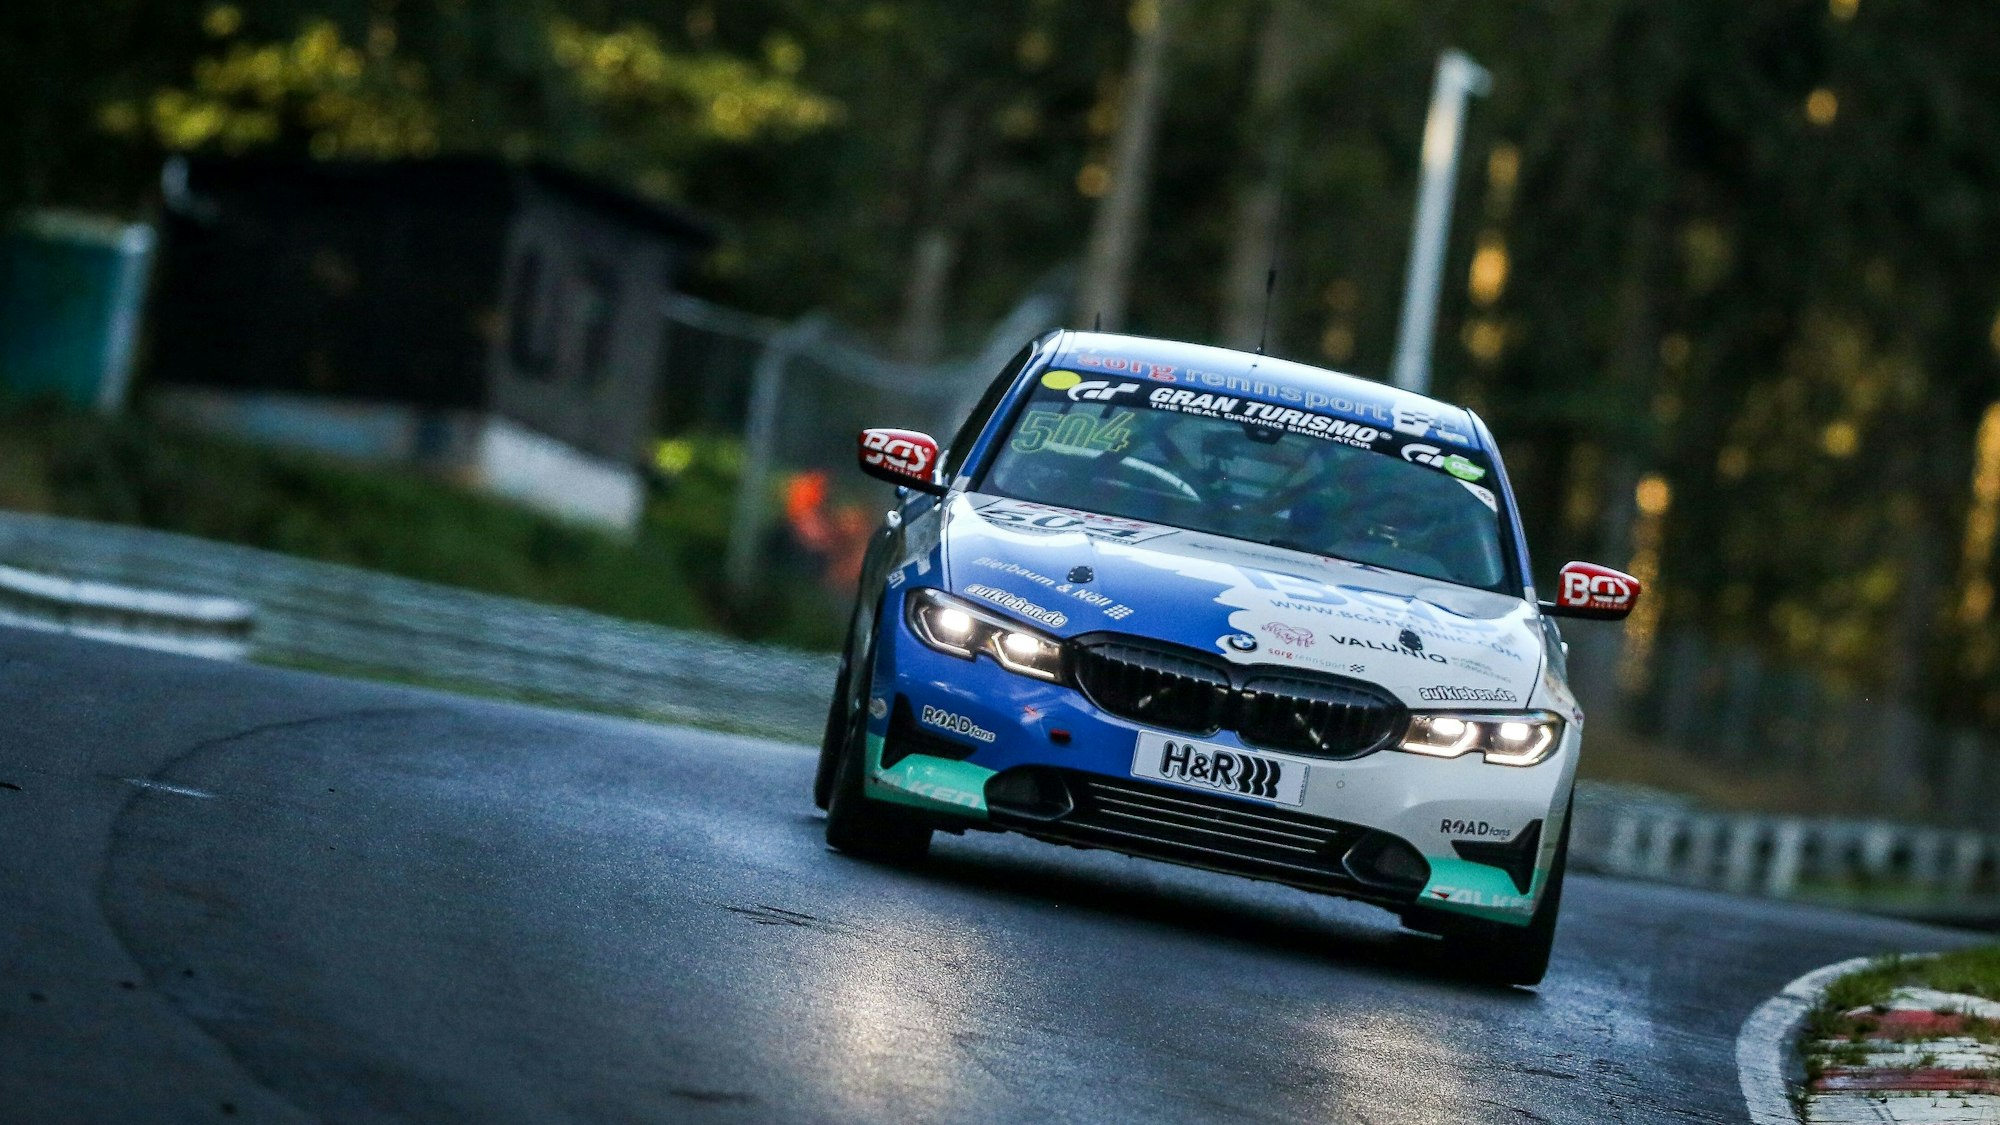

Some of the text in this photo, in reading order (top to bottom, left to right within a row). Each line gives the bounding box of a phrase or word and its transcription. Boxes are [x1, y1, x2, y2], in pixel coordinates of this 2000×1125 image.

[1077, 353, 1389, 421] sorg rennsport
[1149, 387, 1240, 413] GRAN
[1011, 411, 1136, 453] 504
[1151, 401, 1372, 451] THE REAL DRIVING SIMULATOR
[972, 556, 1114, 607] Bierbaum & Nöll
[963, 583, 1069, 628] aufkleben.de
[1419, 685, 1517, 702] aufkleben.de
[1159, 739, 1241, 791] H&R
